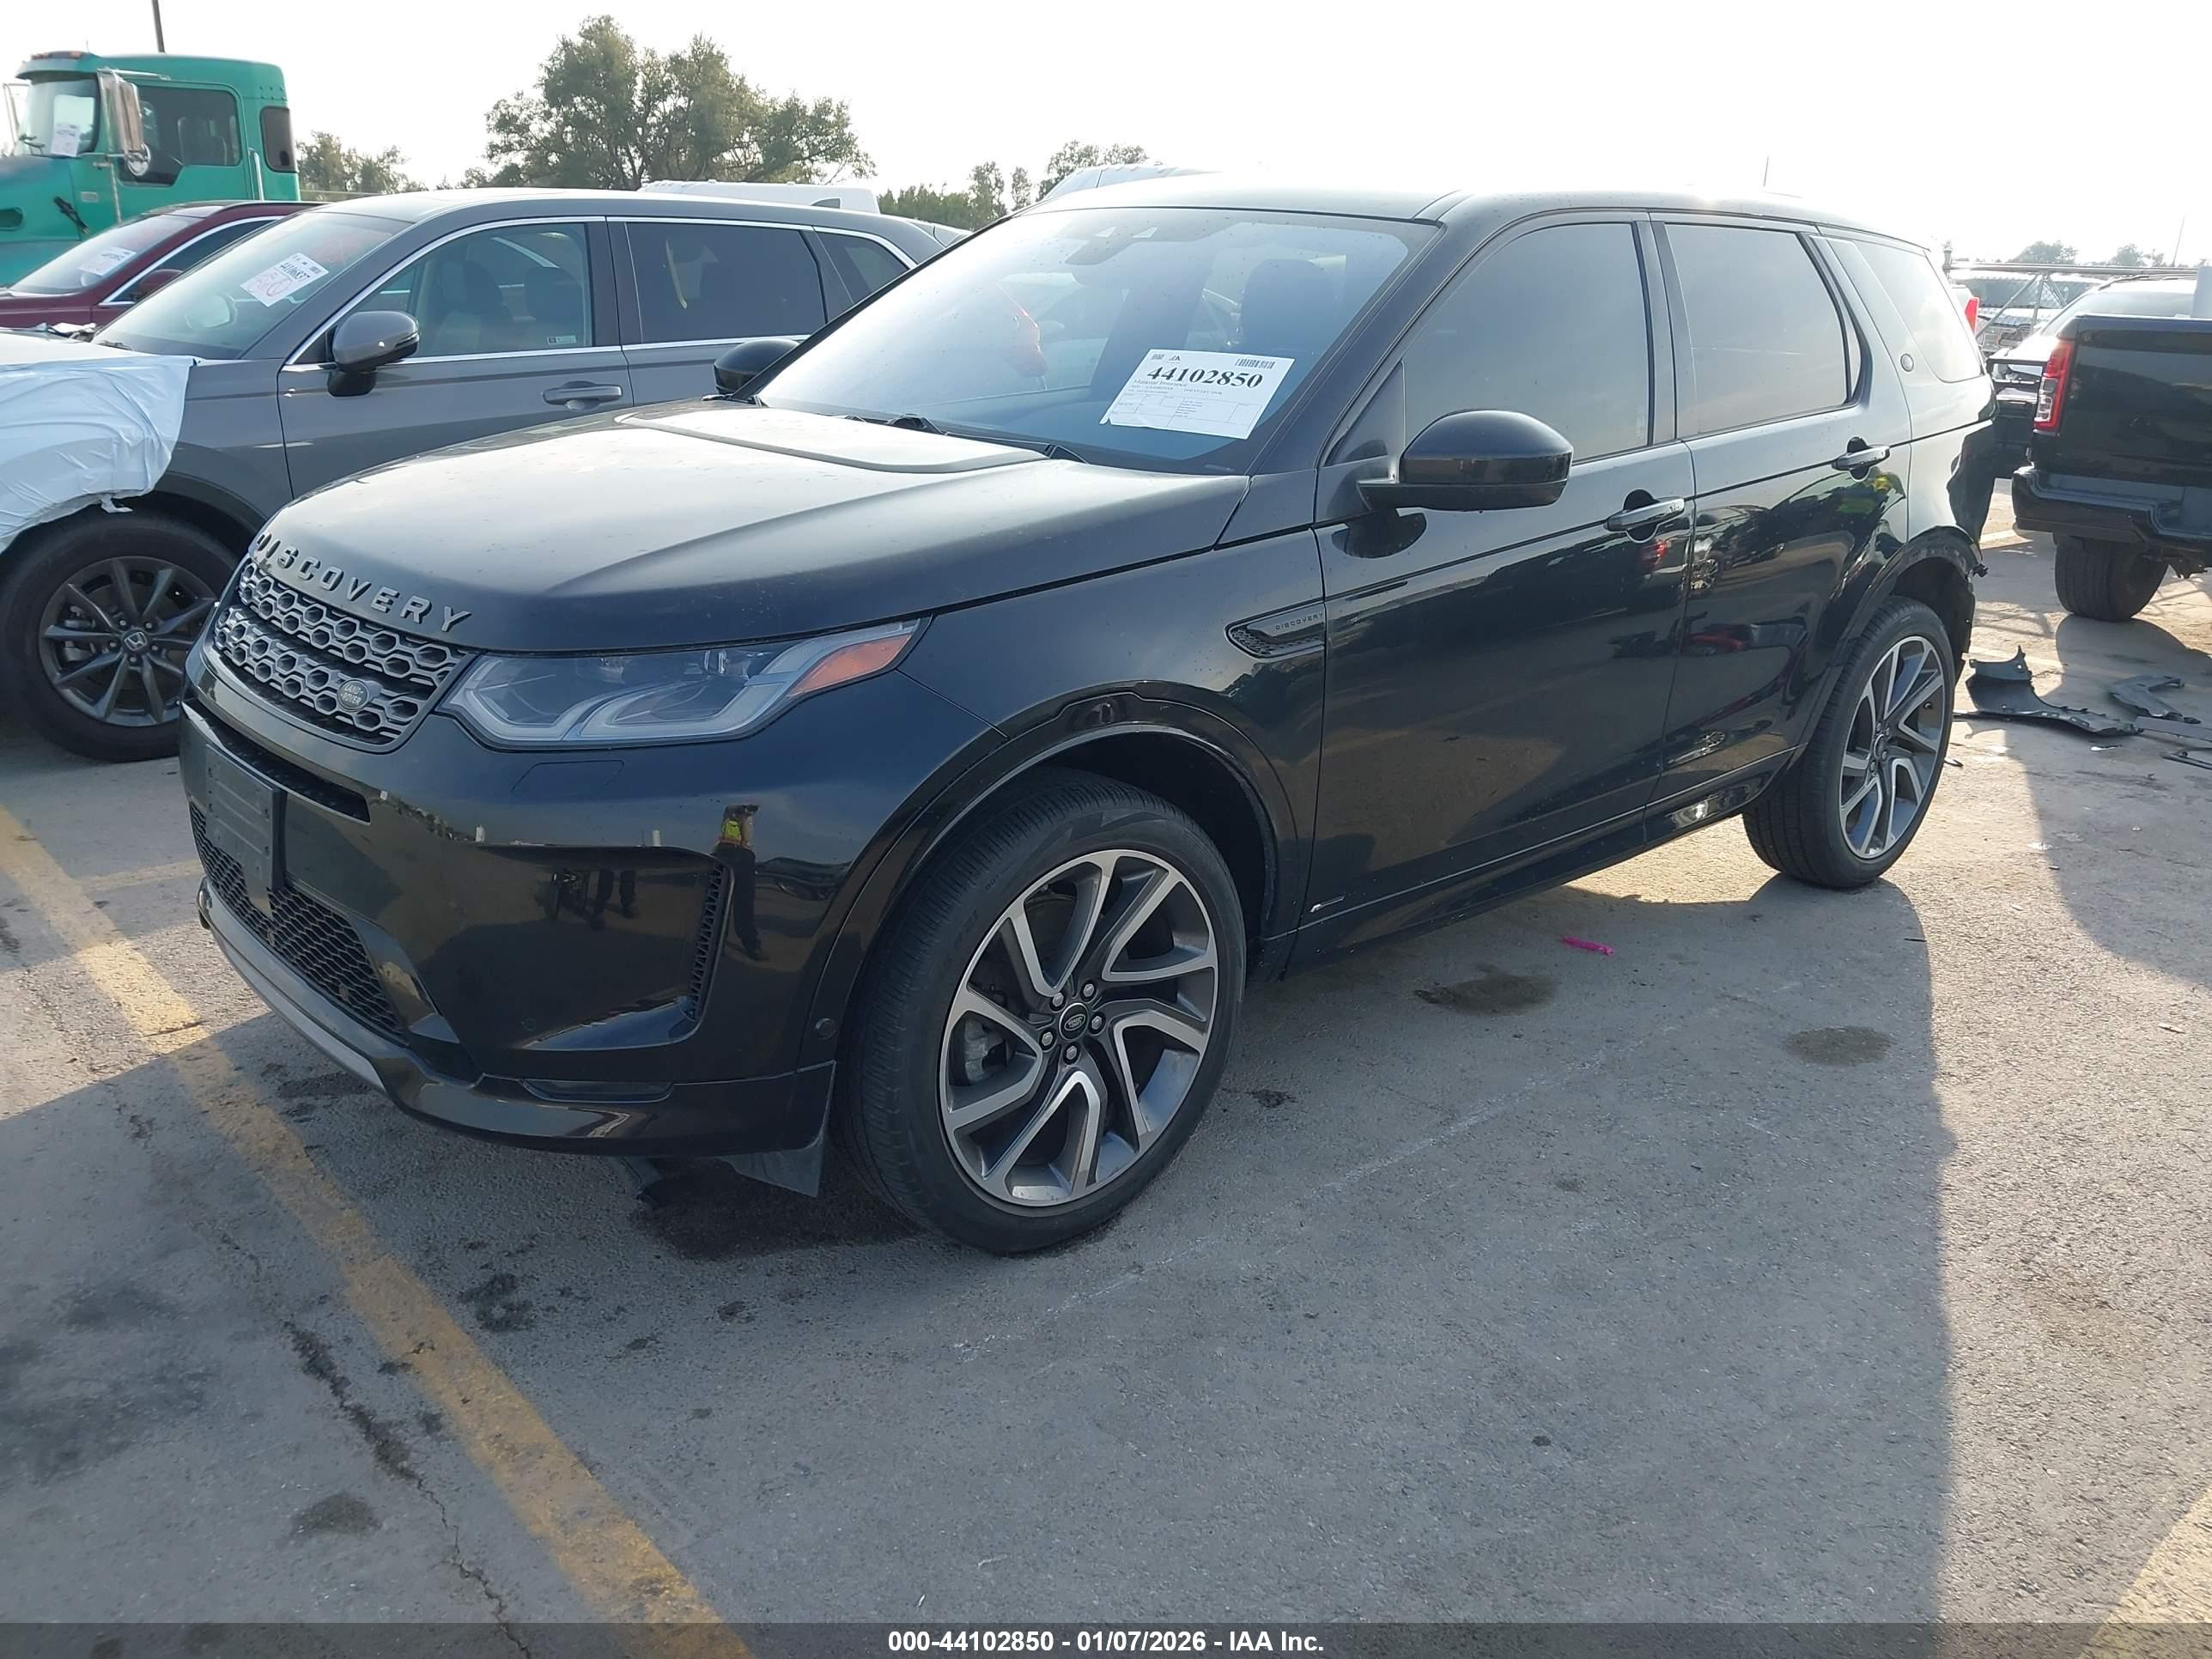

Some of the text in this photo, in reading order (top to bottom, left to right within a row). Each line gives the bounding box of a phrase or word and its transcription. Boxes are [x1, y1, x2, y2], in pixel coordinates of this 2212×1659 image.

[1147, 366, 1263, 388] 44102850
[256, 532, 471, 632] DISCOVERY
[1275, 612, 1322, 629] DISCOVERY
[344, 684, 361, 695] LAND
[343, 692, 362, 705] ROVER
